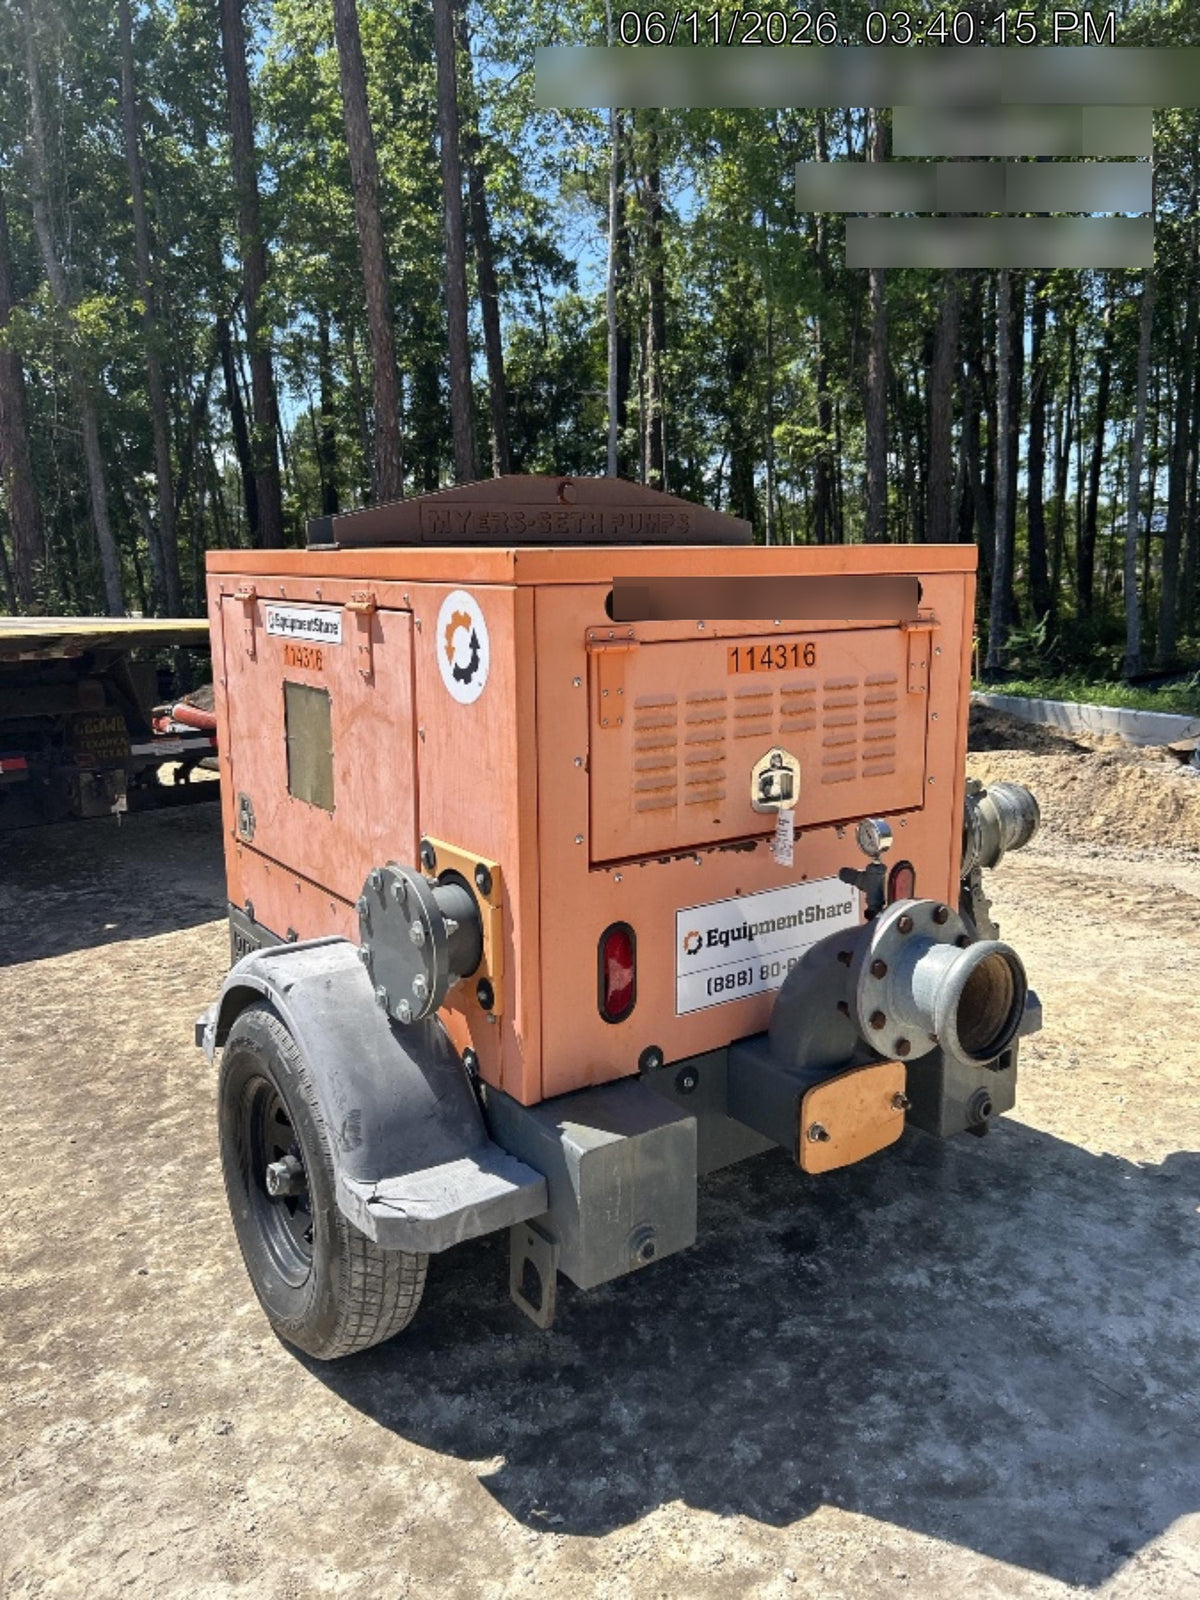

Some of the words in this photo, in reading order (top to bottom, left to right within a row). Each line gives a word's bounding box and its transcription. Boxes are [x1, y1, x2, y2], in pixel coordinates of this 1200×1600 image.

[611, 510, 690, 535] PUMPS
[730, 642, 816, 672] 114316
[706, 900, 853, 947] EquipmentShare
[706, 968, 754, 996] (888)
